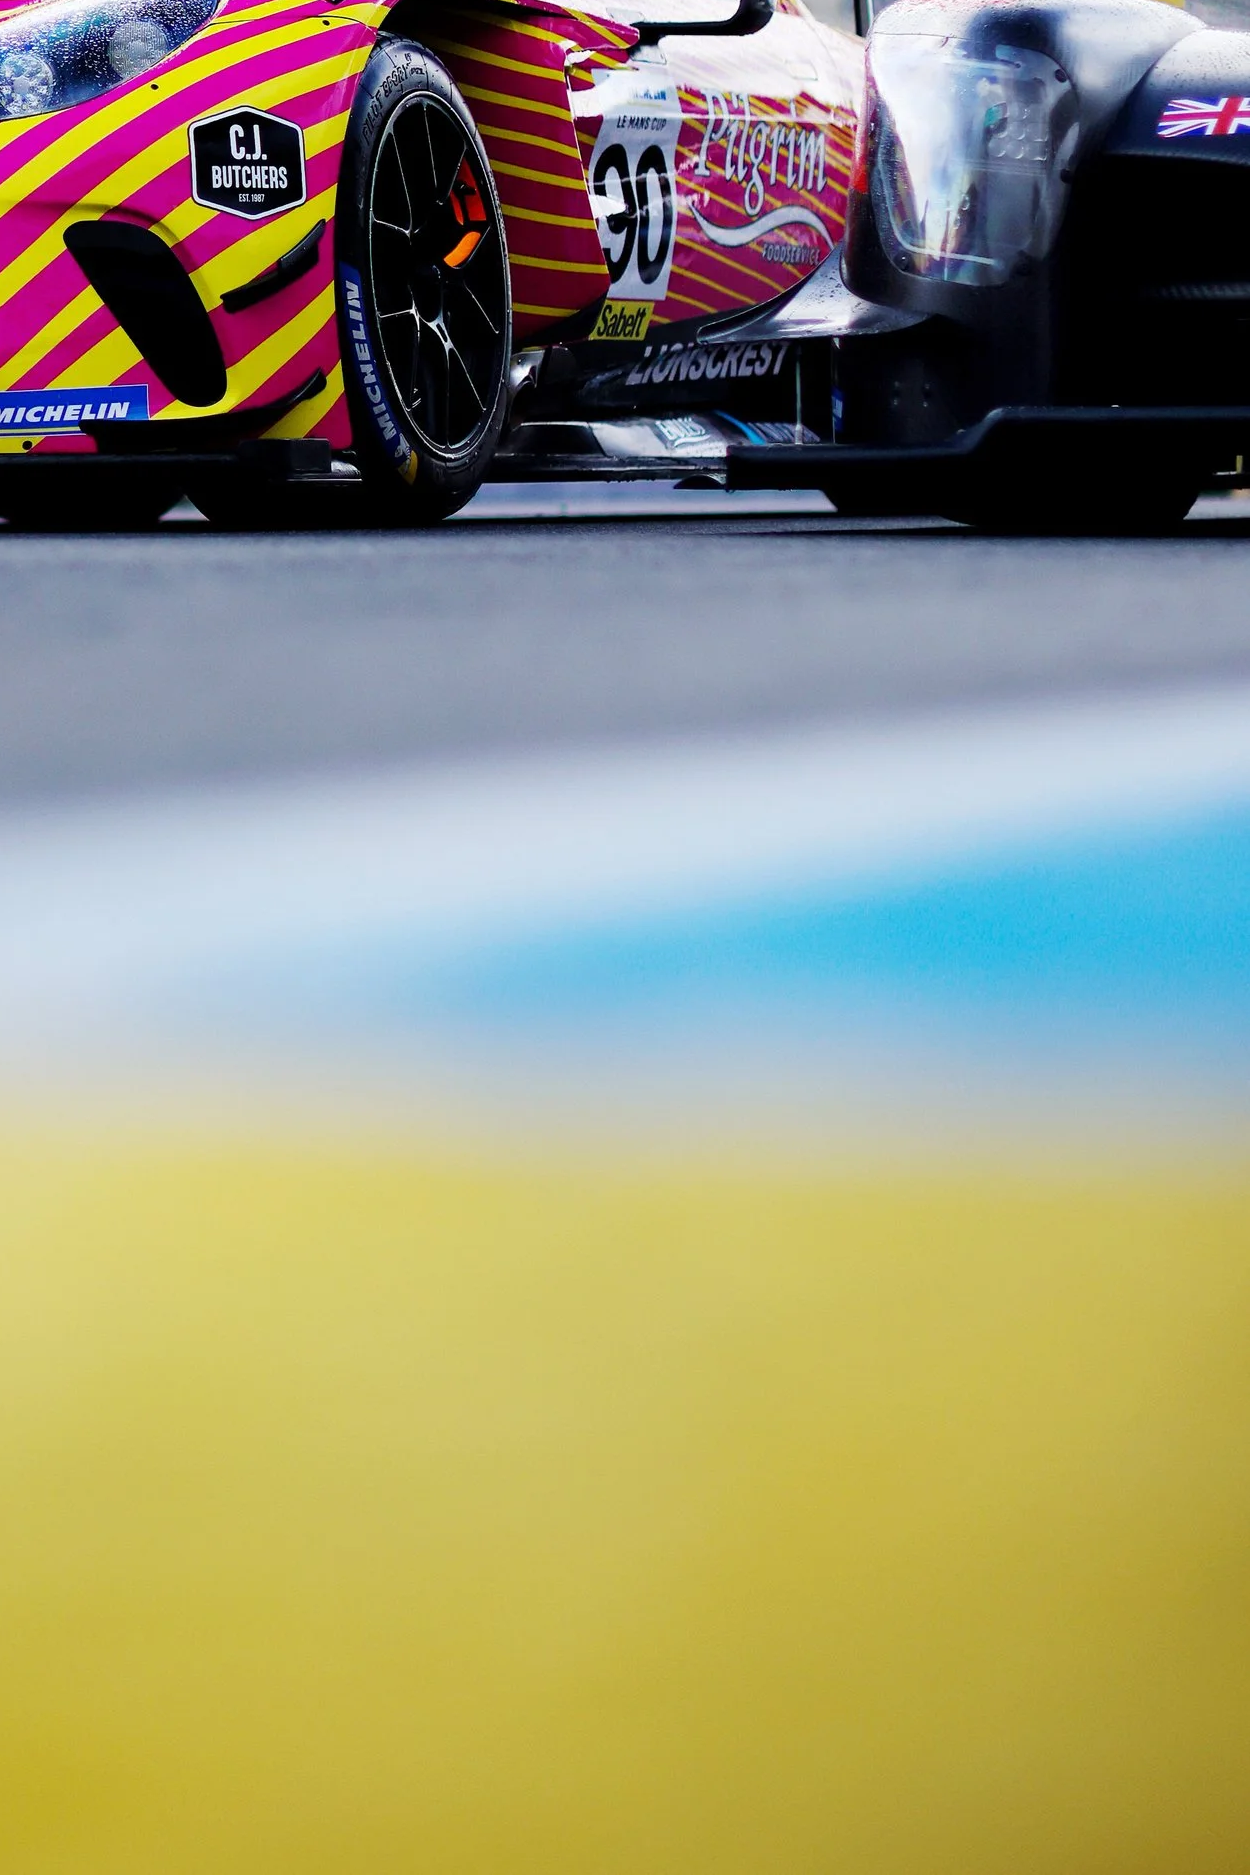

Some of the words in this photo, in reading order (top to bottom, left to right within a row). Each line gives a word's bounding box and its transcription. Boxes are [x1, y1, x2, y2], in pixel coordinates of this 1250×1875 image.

[617, 115, 628, 129] LE
[627, 115, 651, 131] MANS
[650, 116, 667, 132] CUP
[229, 124, 268, 161] C.J.
[694, 88, 827, 217] Pilgrim
[211, 165, 289, 190] BUTCHERS
[238, 193, 251, 203] EST.
[251, 193, 266, 203] 1987
[593, 143, 673, 286] 90
[596, 304, 647, 339] Sabelt
[345, 279, 398, 442] MICHELIN
[625, 341, 793, 386] LIONSCREST
